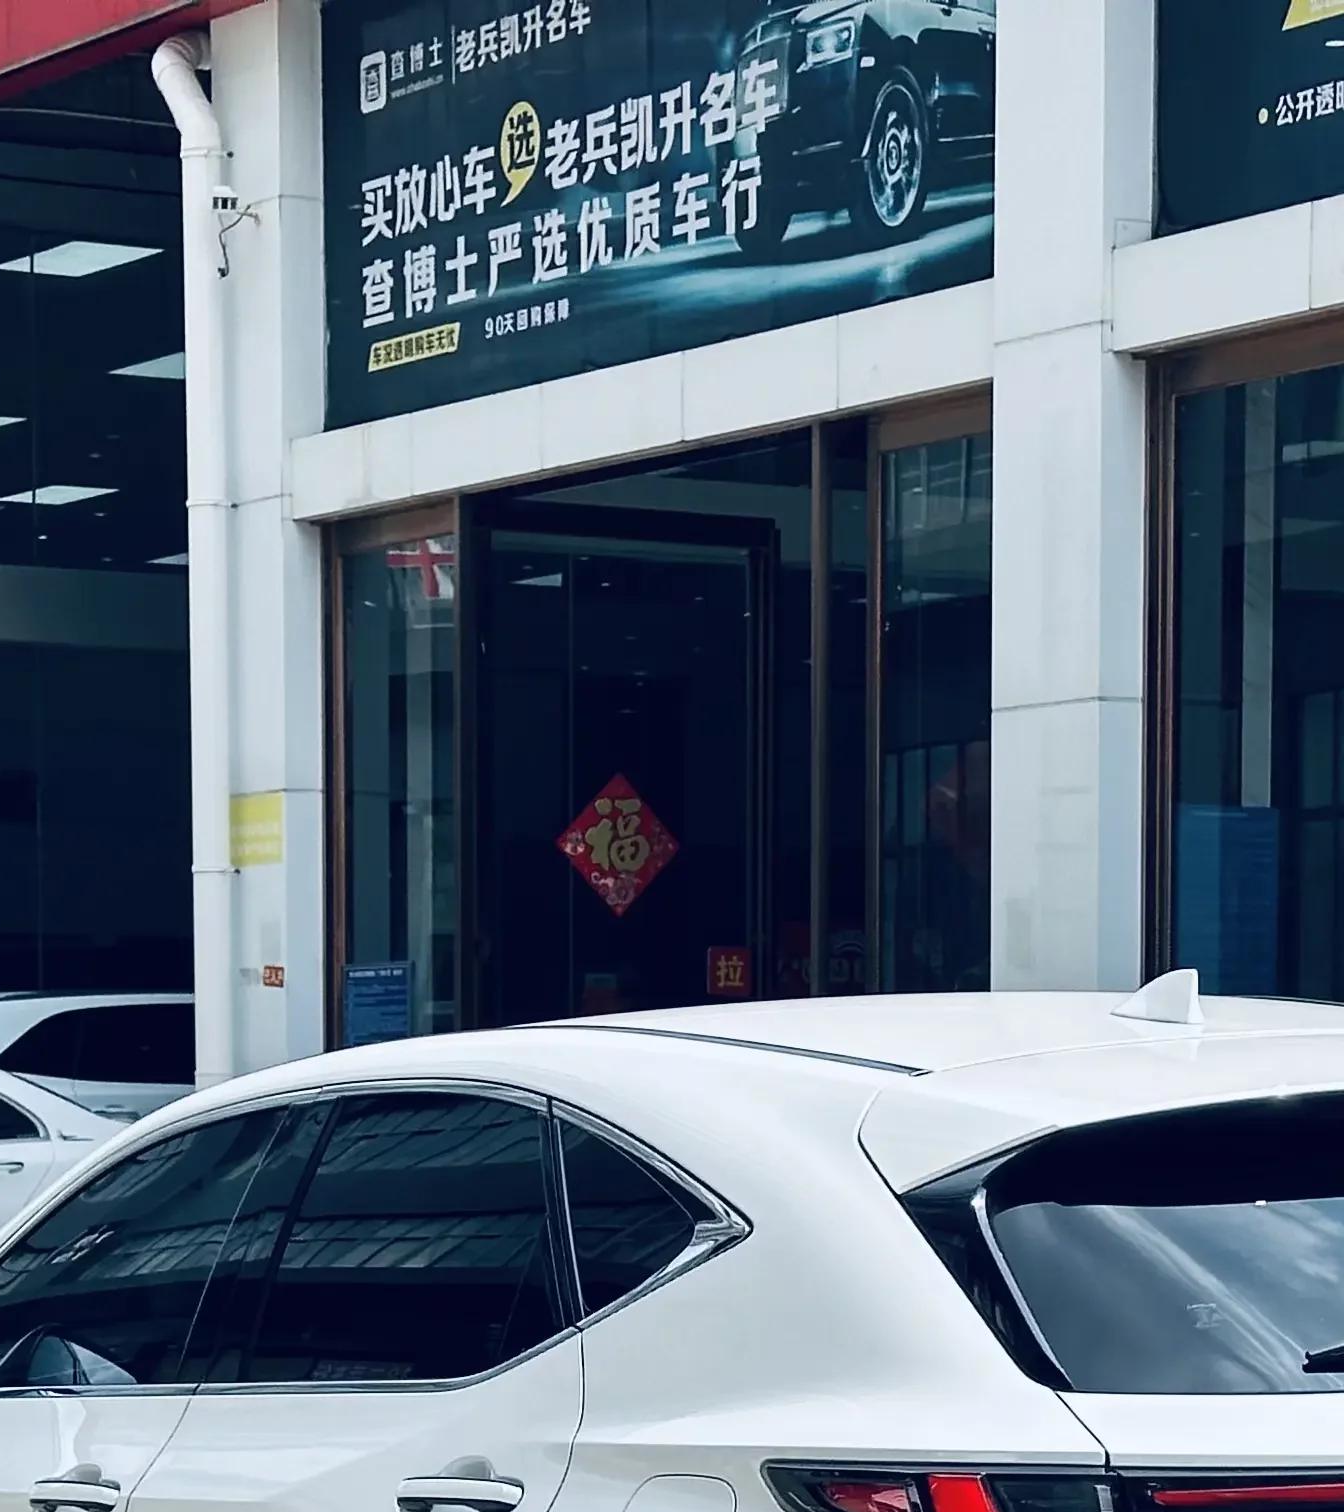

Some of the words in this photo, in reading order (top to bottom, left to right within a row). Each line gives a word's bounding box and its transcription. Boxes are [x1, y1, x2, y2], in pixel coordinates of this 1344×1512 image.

[456, 0, 592, 73] 老兵凯升名车
[361, 156, 763, 328] 查博士严选优质车行
[584, 796, 649, 872] 福
[716, 955, 744, 989] 拉
